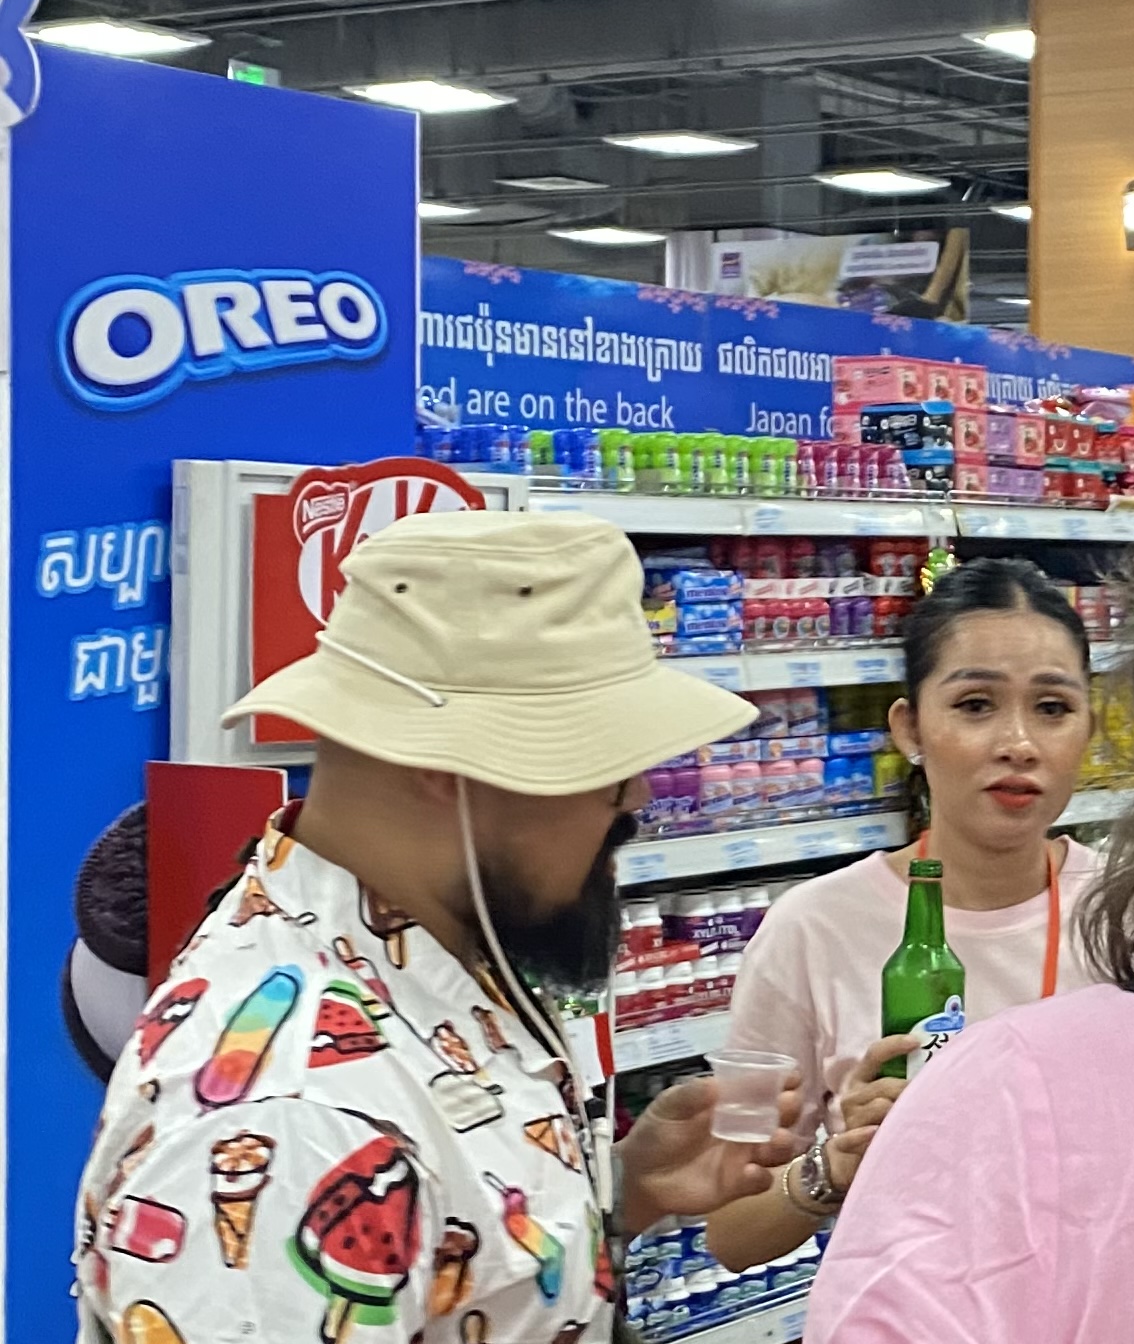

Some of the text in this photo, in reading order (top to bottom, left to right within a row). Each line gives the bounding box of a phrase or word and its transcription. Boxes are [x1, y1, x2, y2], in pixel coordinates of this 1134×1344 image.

[72, 278, 379, 387] OREO
[466, 388, 511, 416] are
[520, 392, 555, 420] on
[564, 387, 607, 424] the
[617, 392, 674, 430] back
[745, 402, 812, 438] Japan
